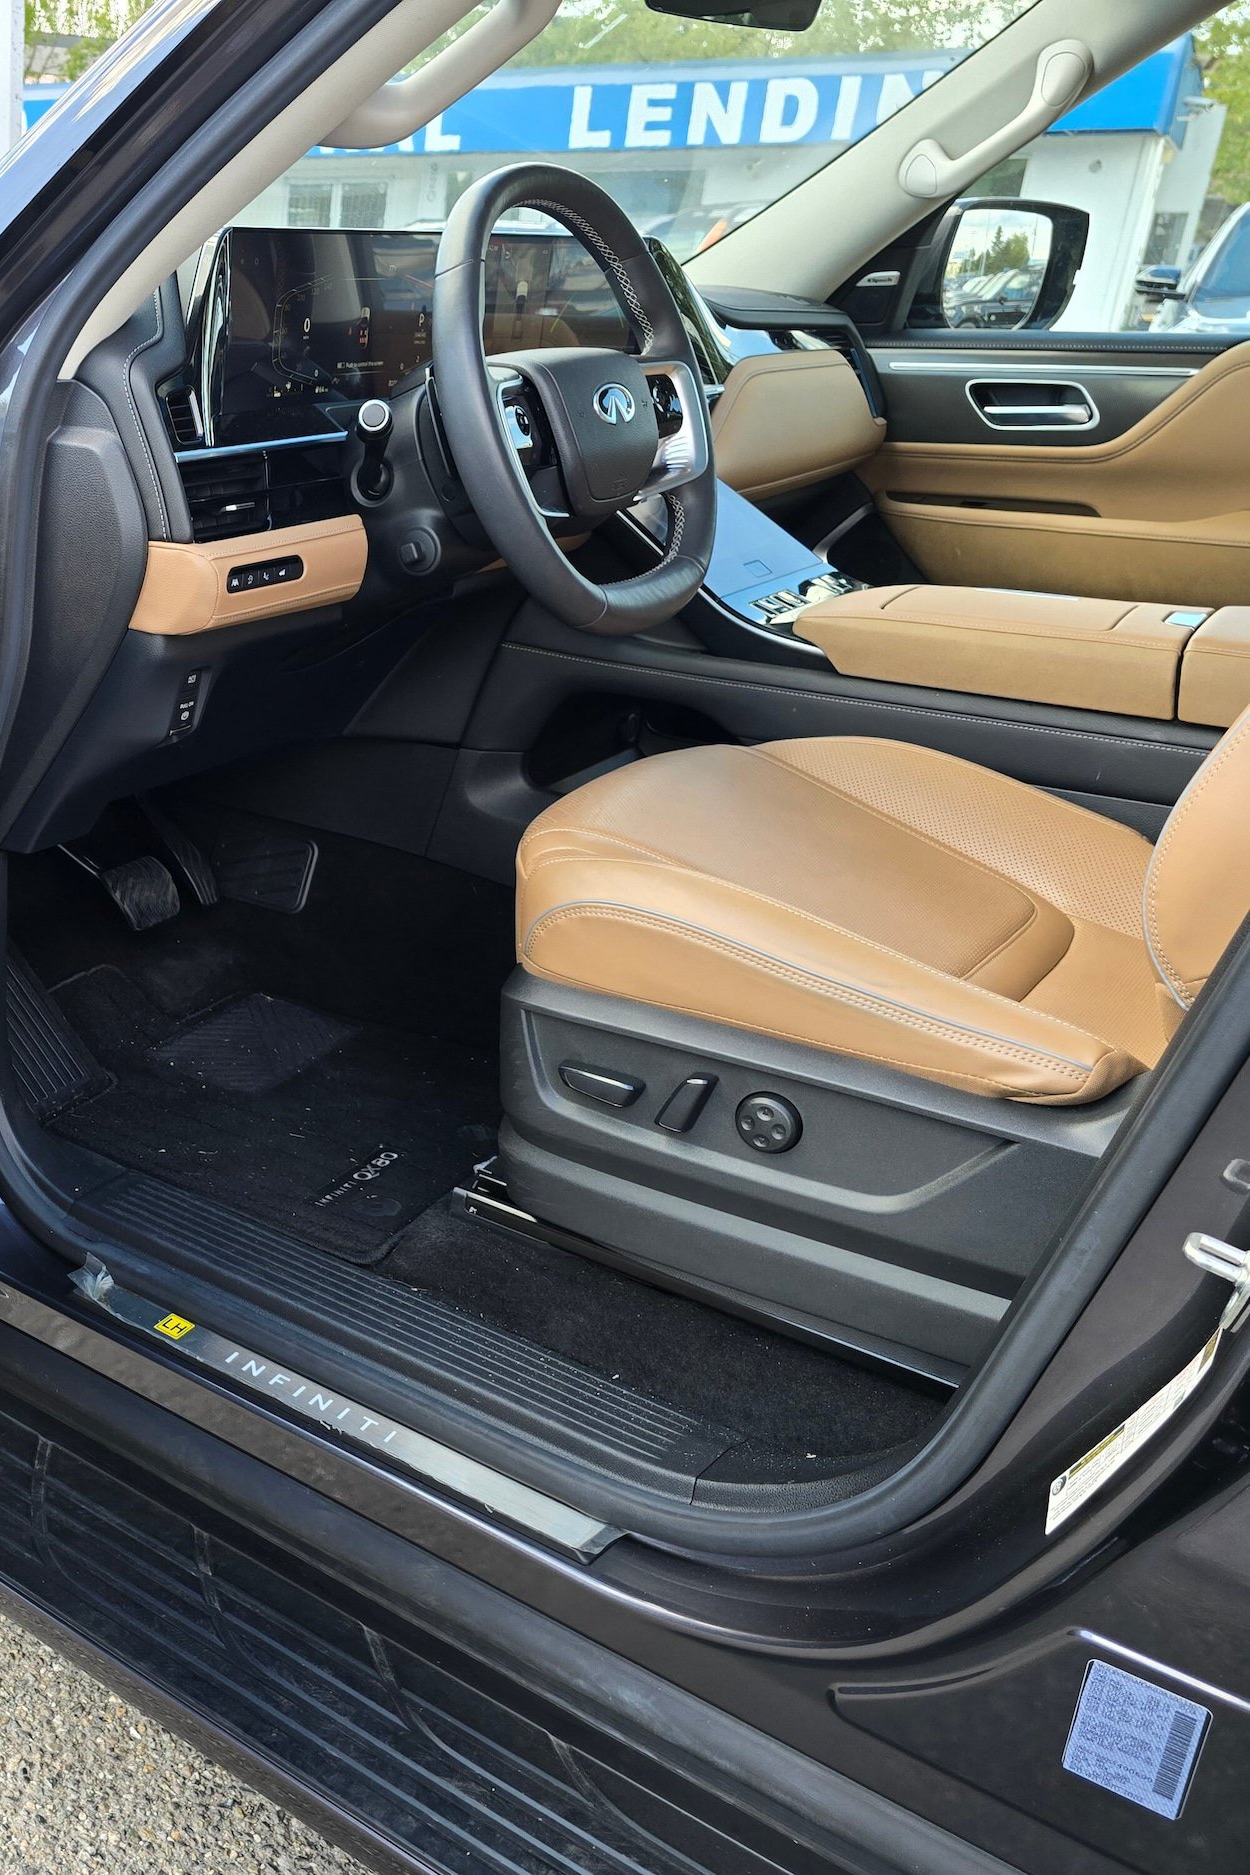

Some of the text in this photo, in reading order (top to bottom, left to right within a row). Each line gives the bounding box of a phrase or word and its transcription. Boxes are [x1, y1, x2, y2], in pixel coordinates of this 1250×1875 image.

[352, 1151, 399, 1181] QX80
[161, 1317, 188, 1335] LH
[225, 1351, 398, 1443] INFINITI
